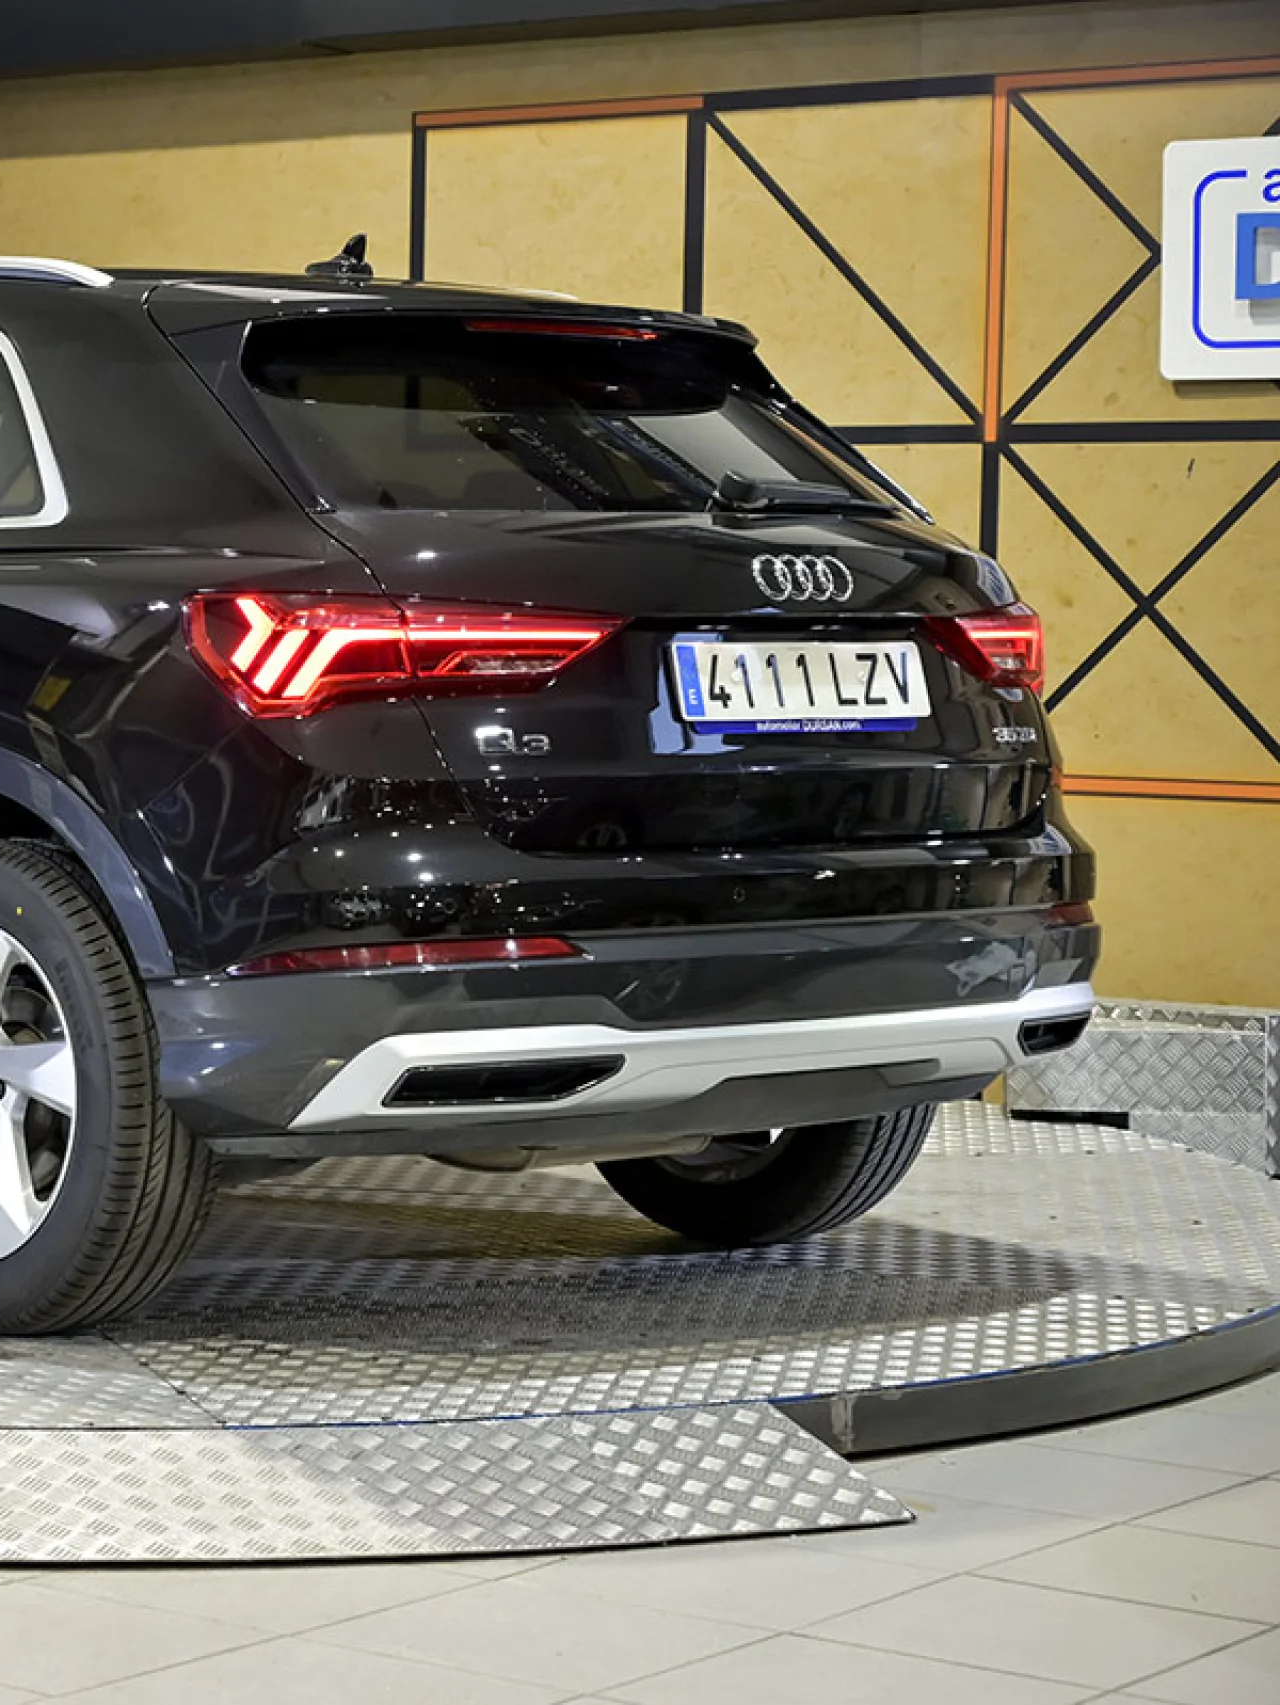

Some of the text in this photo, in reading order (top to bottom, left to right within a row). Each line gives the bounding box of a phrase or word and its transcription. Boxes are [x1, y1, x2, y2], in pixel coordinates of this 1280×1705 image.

[707, 651, 911, 709] 4111 LZV
[688, 688, 699, 706] E
[477, 726, 550, 755] Q3
